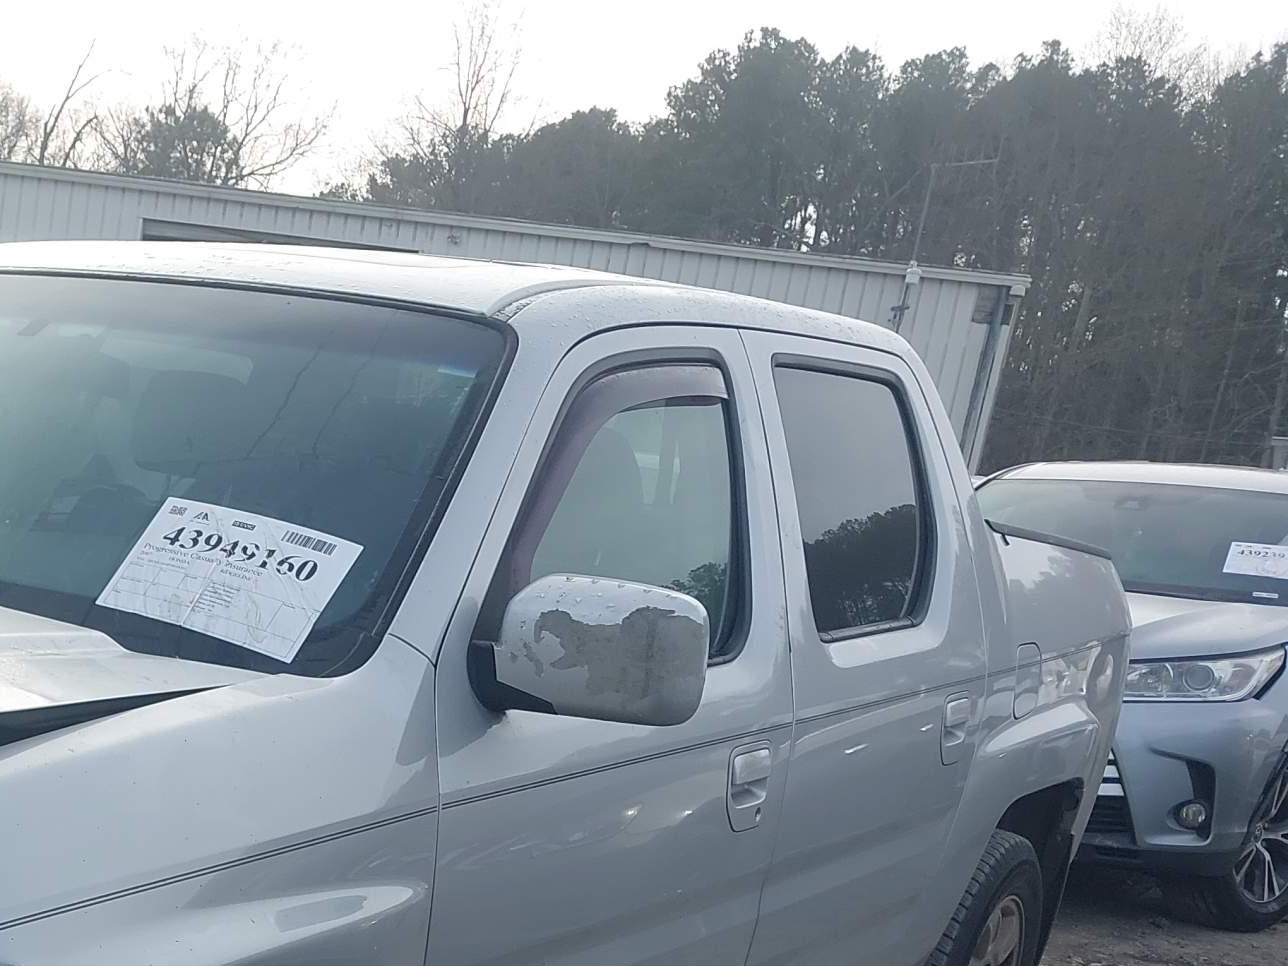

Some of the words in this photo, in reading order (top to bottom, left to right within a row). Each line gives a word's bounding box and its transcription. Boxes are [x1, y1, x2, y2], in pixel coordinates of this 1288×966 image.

[144, 543, 189, 558] Progressive
[223, 560, 264, 577] Insurance
[162, 526, 318, 582] 43949160
